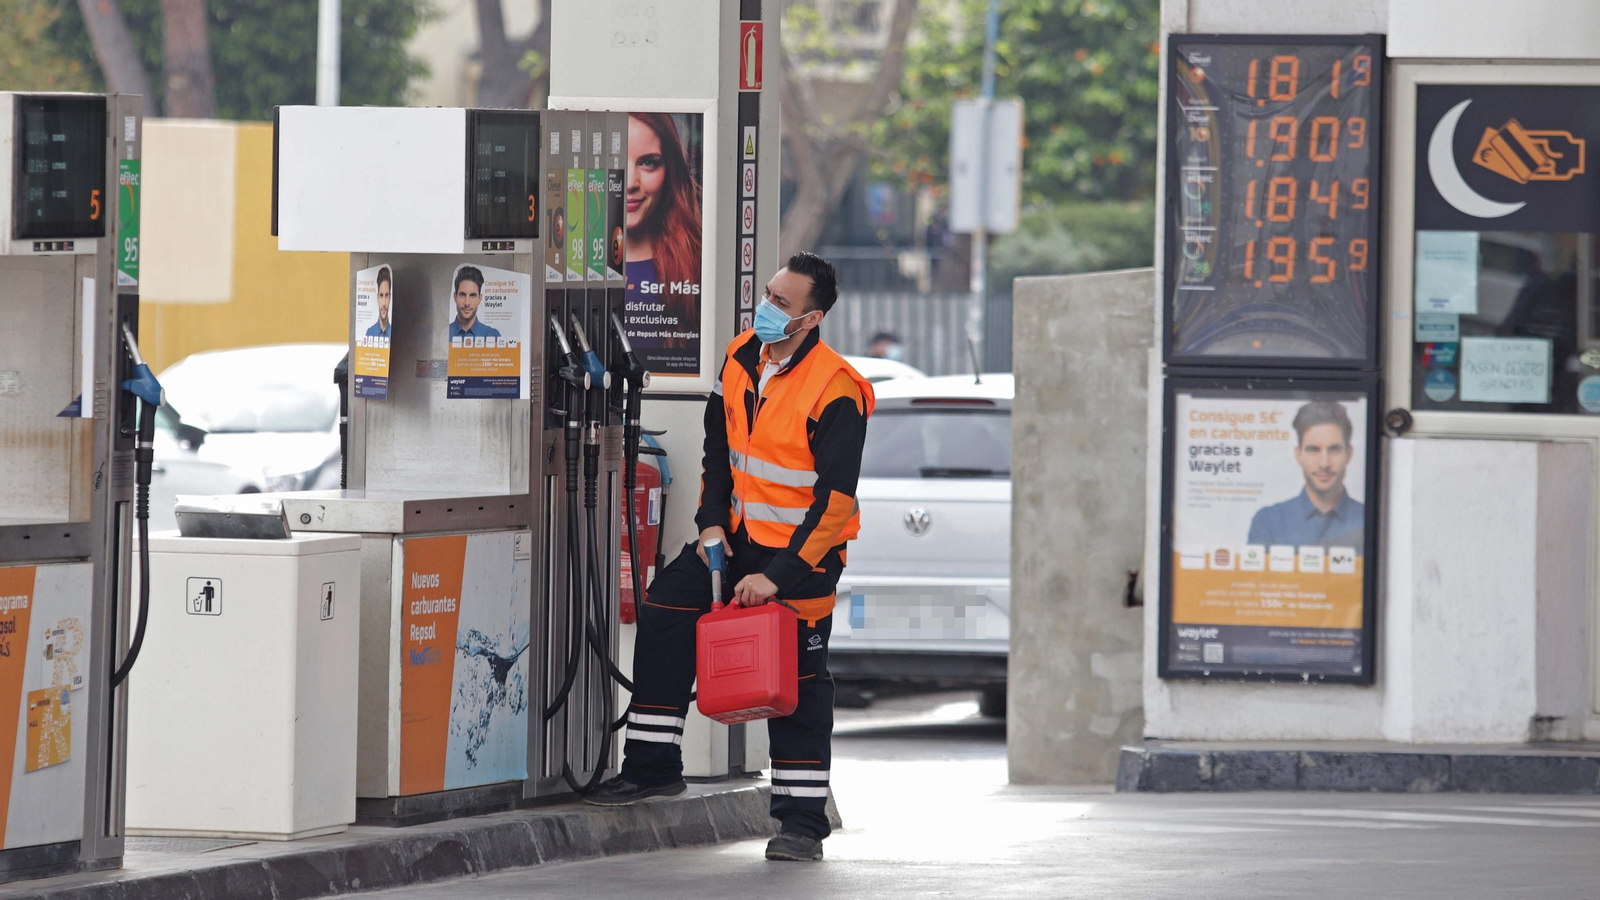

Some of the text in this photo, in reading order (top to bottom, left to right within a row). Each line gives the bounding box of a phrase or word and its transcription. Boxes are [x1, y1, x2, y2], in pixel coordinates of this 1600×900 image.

[547, 179, 562, 192] Diesel
[608, 179, 622, 192] Diesel
[90, 189, 101, 221] 5
[528, 194, 535, 222] 3
[124, 236, 138, 265] 95
[572, 238, 583, 261] 98
[593, 238, 604, 261] 95
[485, 280, 507, 288] Consigue
[640, 279, 700, 295] Ser Más
[484, 294, 502, 302] gracias
[484, 301, 503, 309] Waylet
[625, 301, 665, 312] disfrutar
[629, 315, 678, 325] exclusivas
[636, 330, 658, 339] Repsol
[659, 330, 672, 338] Más
[672, 331, 699, 340] Energías
[1188, 410, 1256, 426] Consigue
[1188, 428, 1289, 441] en carburante
[1188, 443, 1253, 458] gracias a
[1188, 460, 1242, 475] Waylet
[411, 572, 440, 590] Nuevos
[411, 596, 456, 615] carburantes
[410, 620, 436, 645] Repsol
[73, 675, 83, 686] VISA
